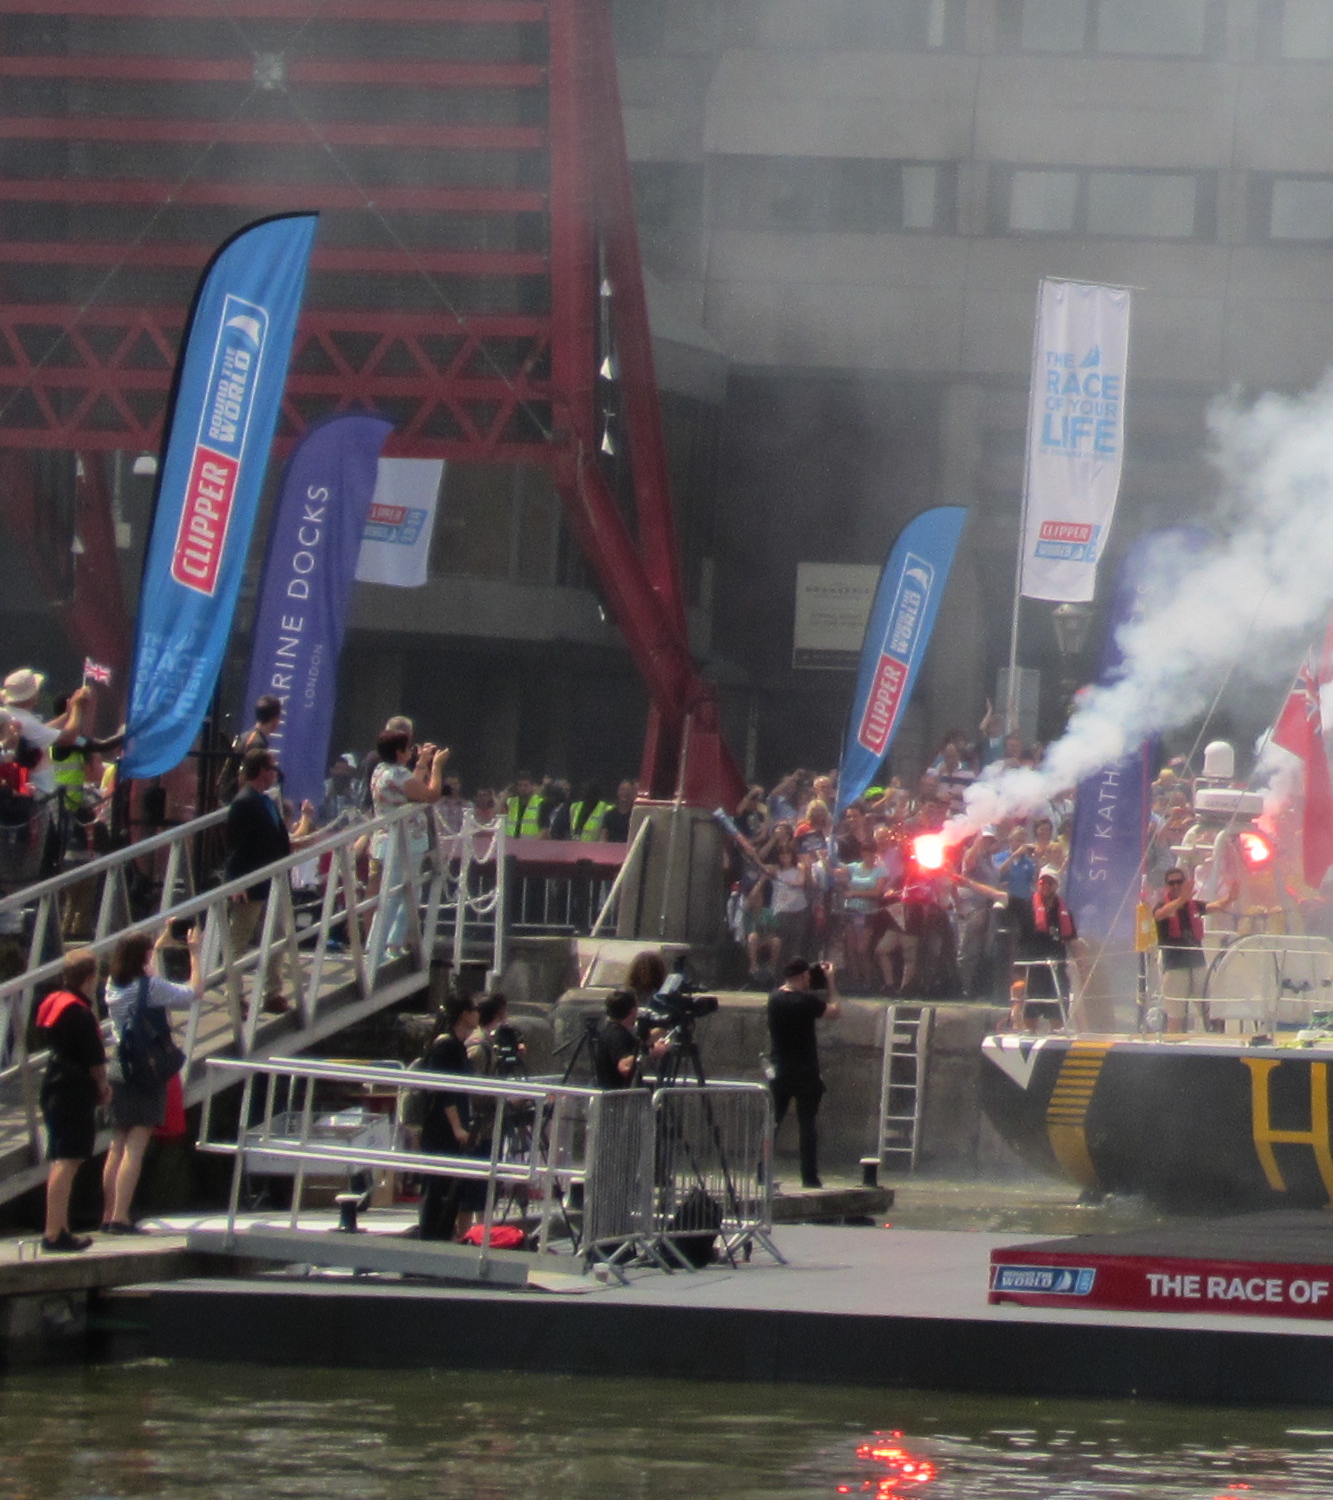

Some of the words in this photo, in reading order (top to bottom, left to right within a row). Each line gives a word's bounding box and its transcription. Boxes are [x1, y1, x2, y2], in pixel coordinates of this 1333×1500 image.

[1045, 350, 1075, 369] THE
[218, 352, 251, 443] WORLD
[1046, 369, 1120, 401] RACE
[209, 378, 231, 440] ROUND
[1044, 396, 1064, 411] OF
[1068, 399, 1118, 418] YOUR
[1041, 413, 1117, 453] LIFE
[182, 460, 230, 580] CLIPPER
[287, 484, 329, 600] DOCKS
[303, 643, 324, 708] LONDON
[865, 664, 902, 745] CLIPPER
[1089, 853, 1107, 882] ST
[1002, 1275, 1053, 1288] WORLD
[1147, 1273, 1202, 1299] THE
[1207, 1277, 1283, 1303] RACE
[1288, 1279, 1329, 1305] OF
